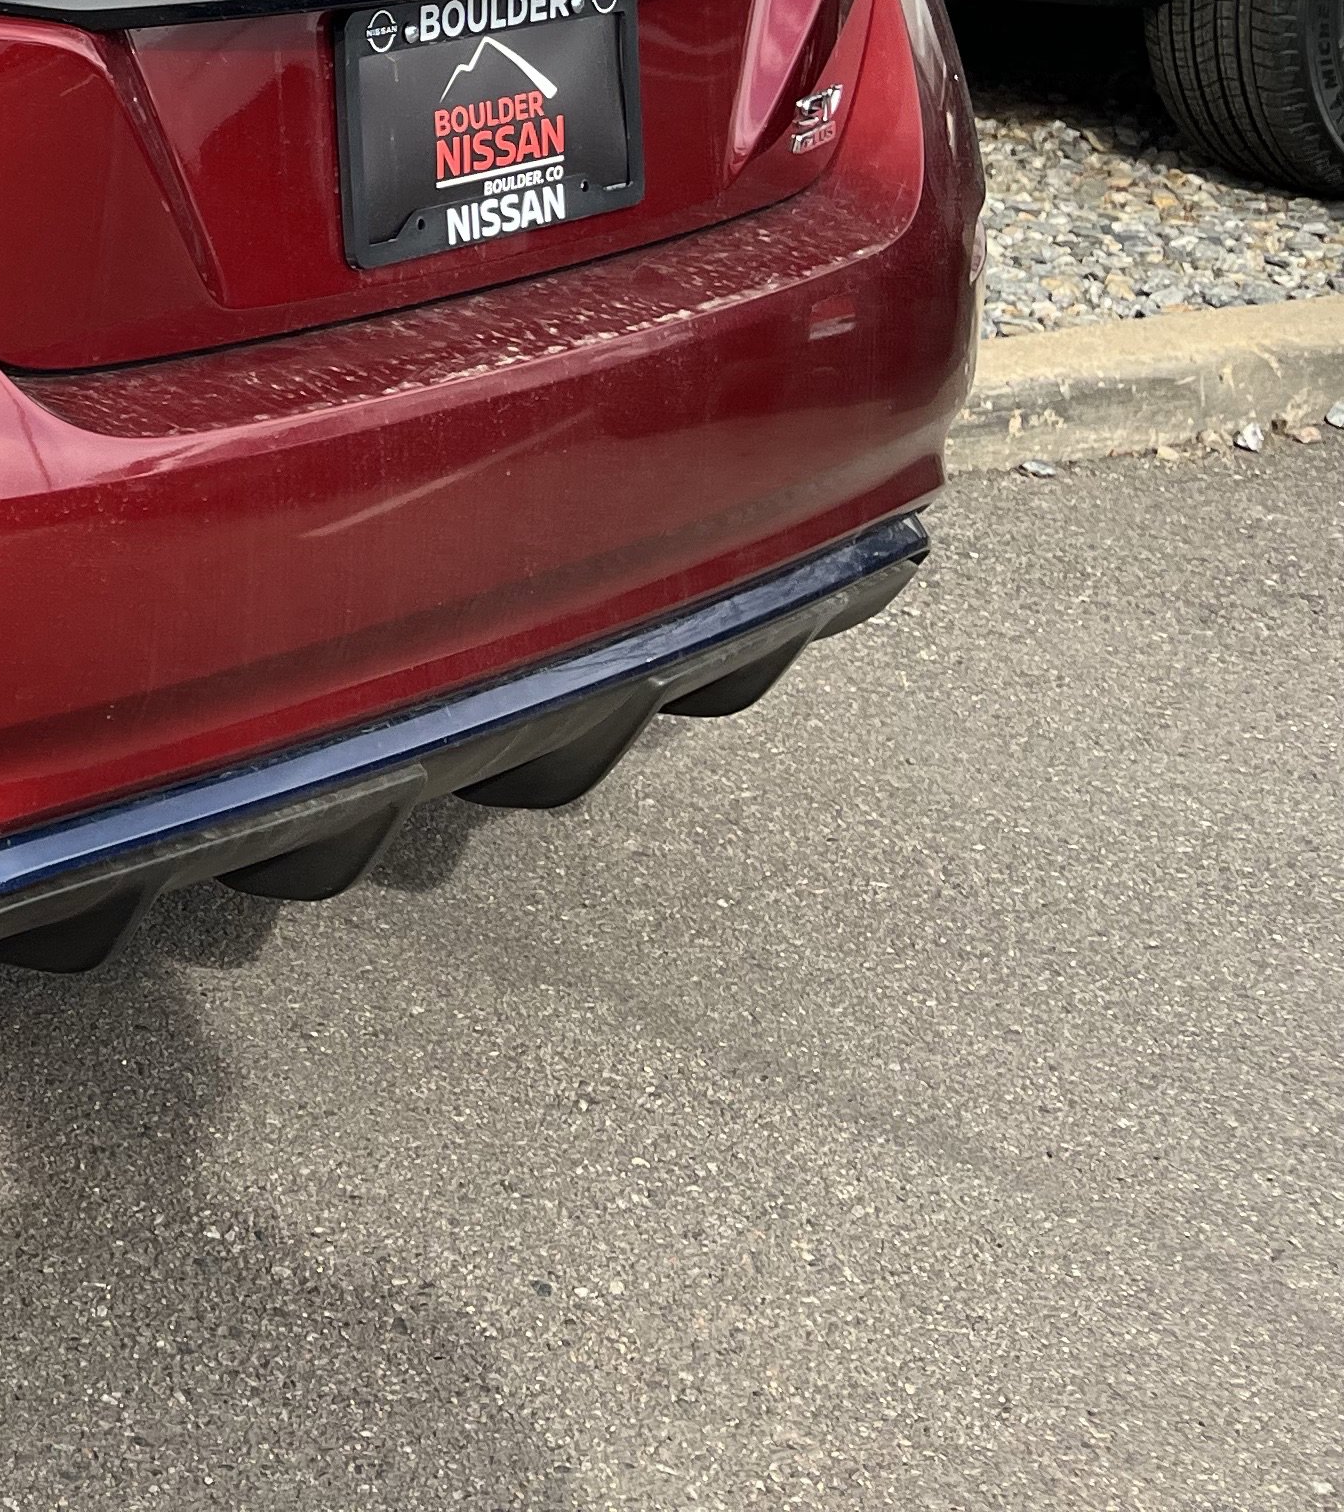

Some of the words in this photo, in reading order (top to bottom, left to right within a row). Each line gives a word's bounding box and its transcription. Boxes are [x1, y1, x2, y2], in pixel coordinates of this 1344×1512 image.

[366, 24, 397, 38] NISSAN
[434, 90, 545, 137] BOULDER
[436, 114, 565, 180] NISSAN
[546, 165, 564, 181] CO
[446, 183, 566, 246] NISSAN
